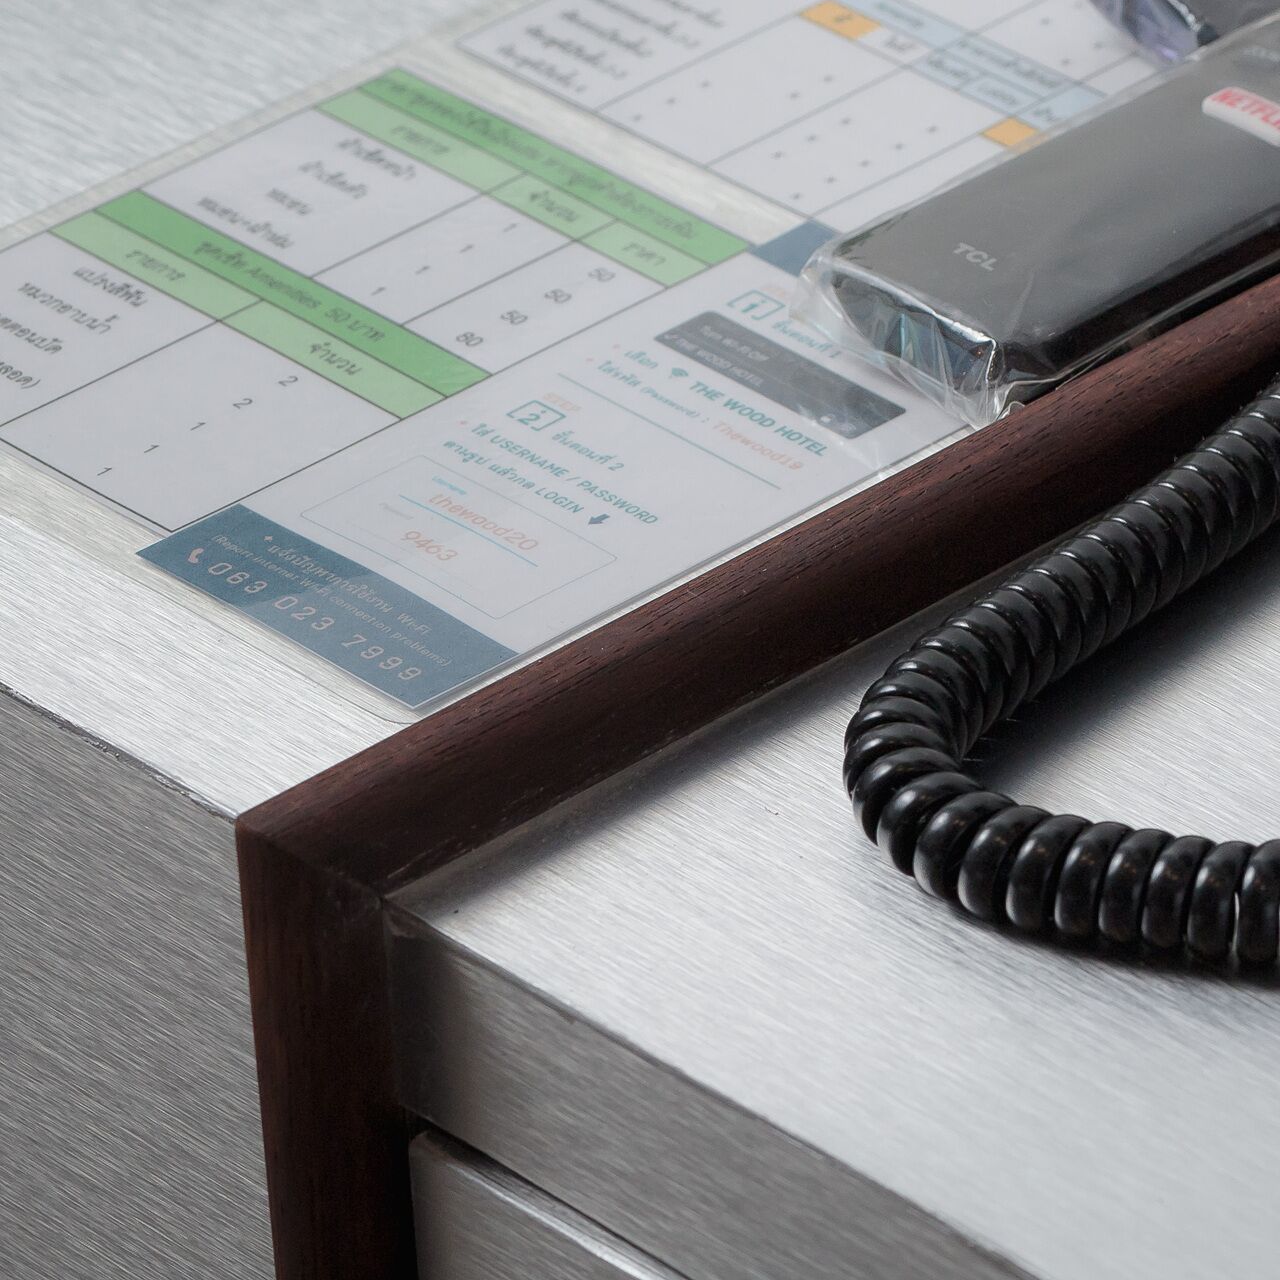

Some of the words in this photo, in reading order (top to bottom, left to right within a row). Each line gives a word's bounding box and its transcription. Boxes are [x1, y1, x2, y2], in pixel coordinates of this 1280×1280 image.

[953, 241, 996, 272] TCL
[278, 375, 299, 387] 2
[232, 397, 254, 410] 2
[689, 381, 726, 403] THE
[722, 399, 776, 430] WOOD
[774, 424, 829, 458] HOTEL
[490, 434, 568, 479] USERNAME
[575, 478, 660, 526] PASSWORD
[608, 459, 626, 473] 2
[534, 487, 586, 516] LOGIN
[427, 493, 541, 554] thewood20
[400, 528, 460, 563] 9463
[207, 561, 268, 595] 063
[271, 594, 336, 633] 023
[341, 632, 424, 681] 7999
